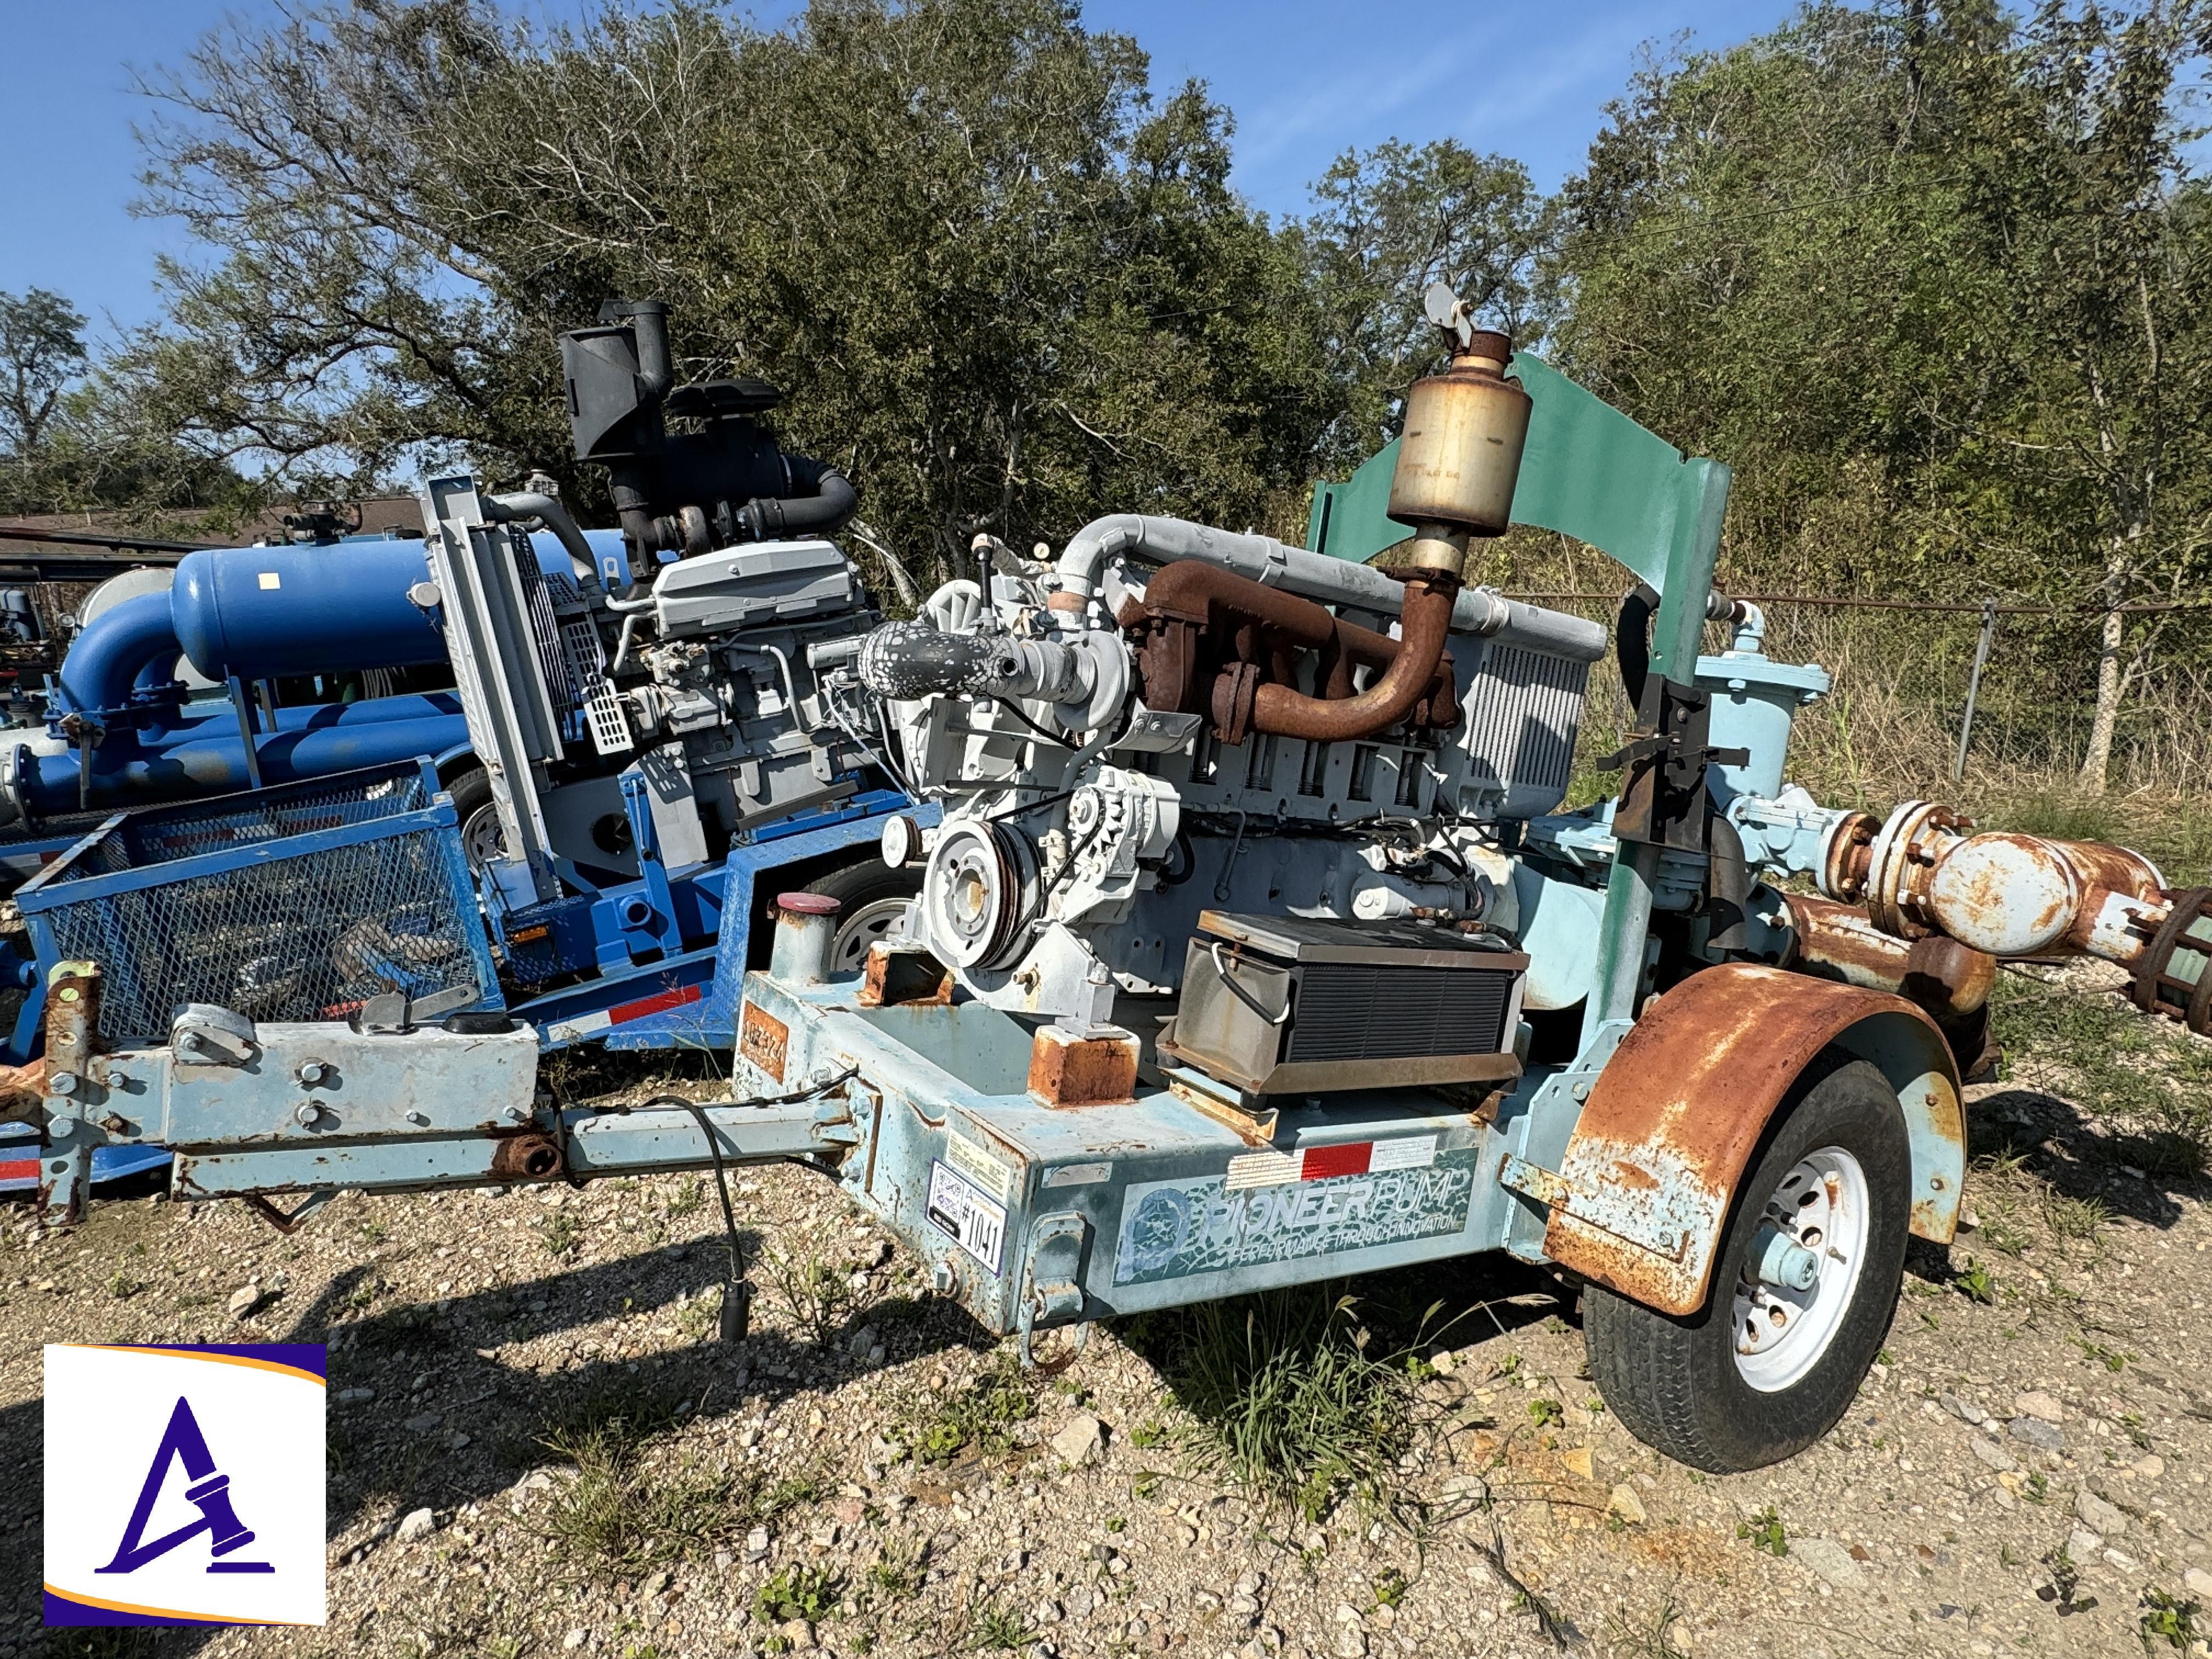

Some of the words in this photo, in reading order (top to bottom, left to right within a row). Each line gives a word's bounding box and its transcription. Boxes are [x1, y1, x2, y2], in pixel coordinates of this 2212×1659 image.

[961, 1202, 999, 1266] #1041
[1199, 1182, 1374, 1241] PIONEER
[1369, 1167, 1471, 1218] PUMP
[1232, 1234, 1330, 1261] PERFORMANCE
[1390, 1214, 1457, 1239] INNOVATION
